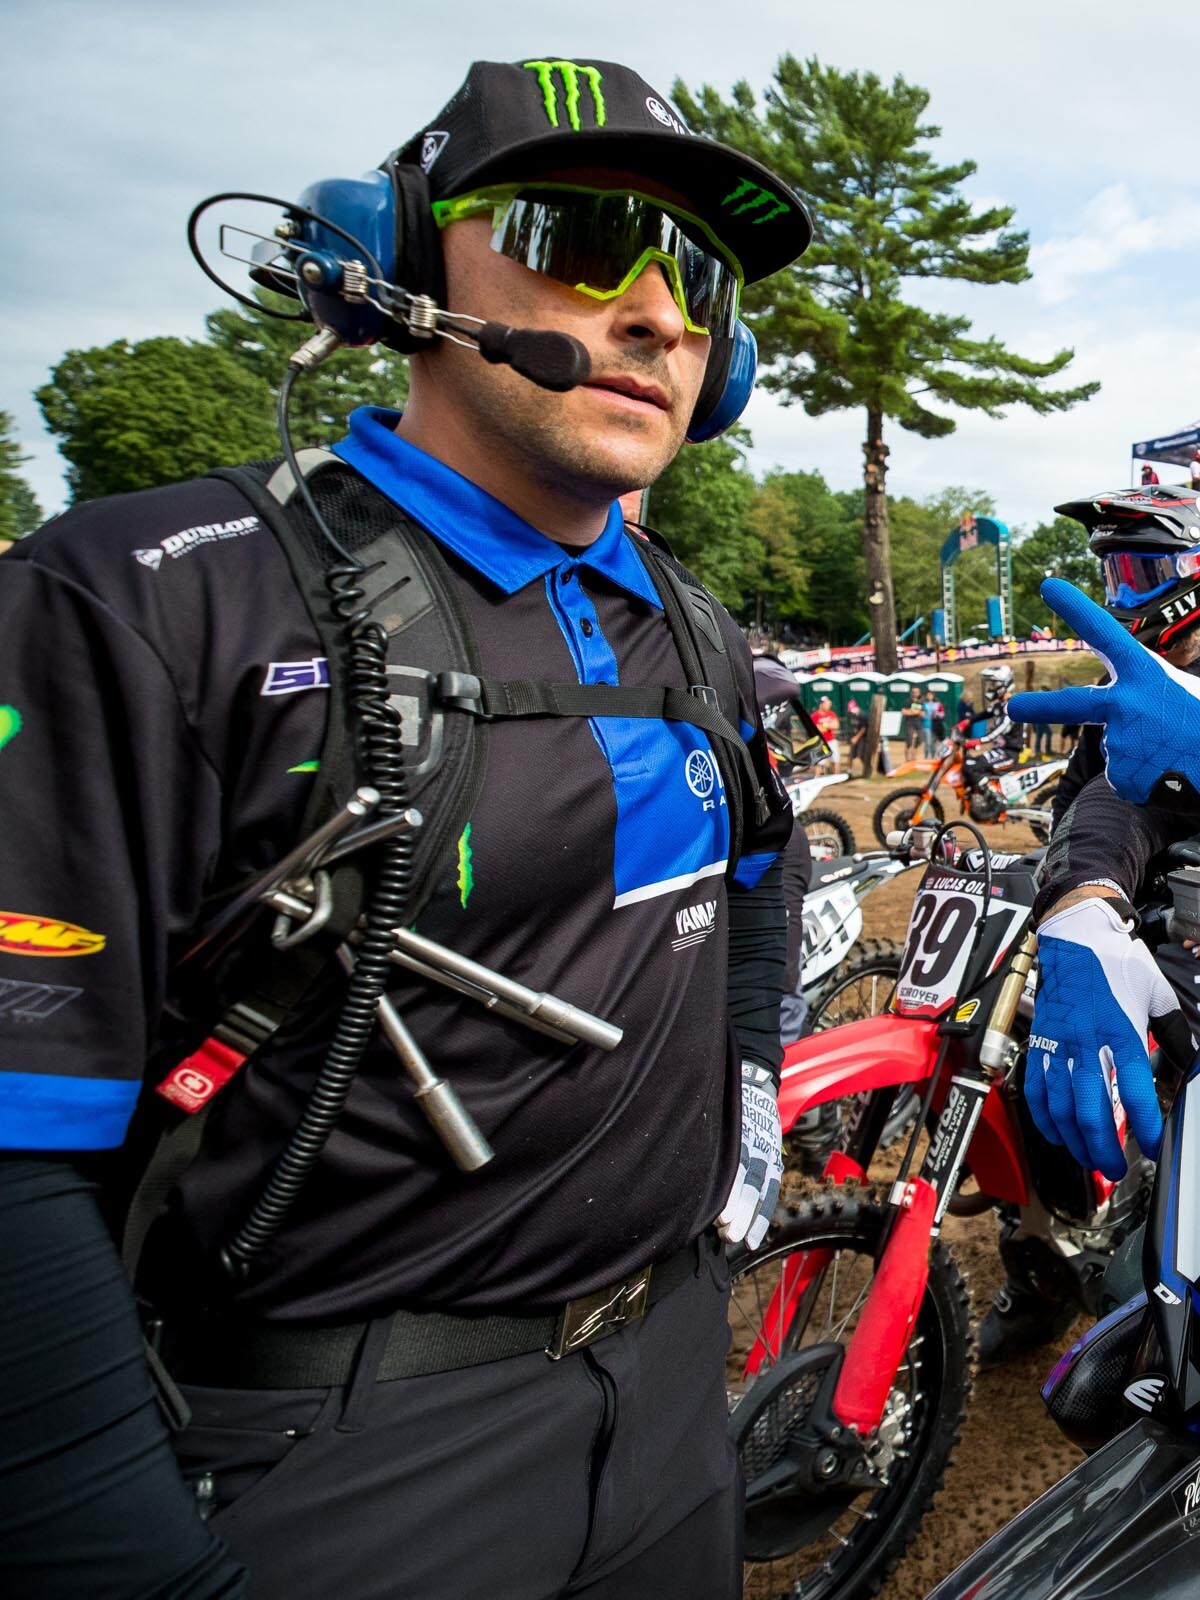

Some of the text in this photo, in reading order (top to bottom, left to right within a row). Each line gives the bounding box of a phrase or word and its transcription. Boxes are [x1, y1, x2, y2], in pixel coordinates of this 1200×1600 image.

[160, 515, 260, 555] DUNLOP
[1161, 591, 1197, 624] FLY
[933, 876, 987, 895] LUCAS OIL
[1028, 1034, 1059, 1054] THOR
